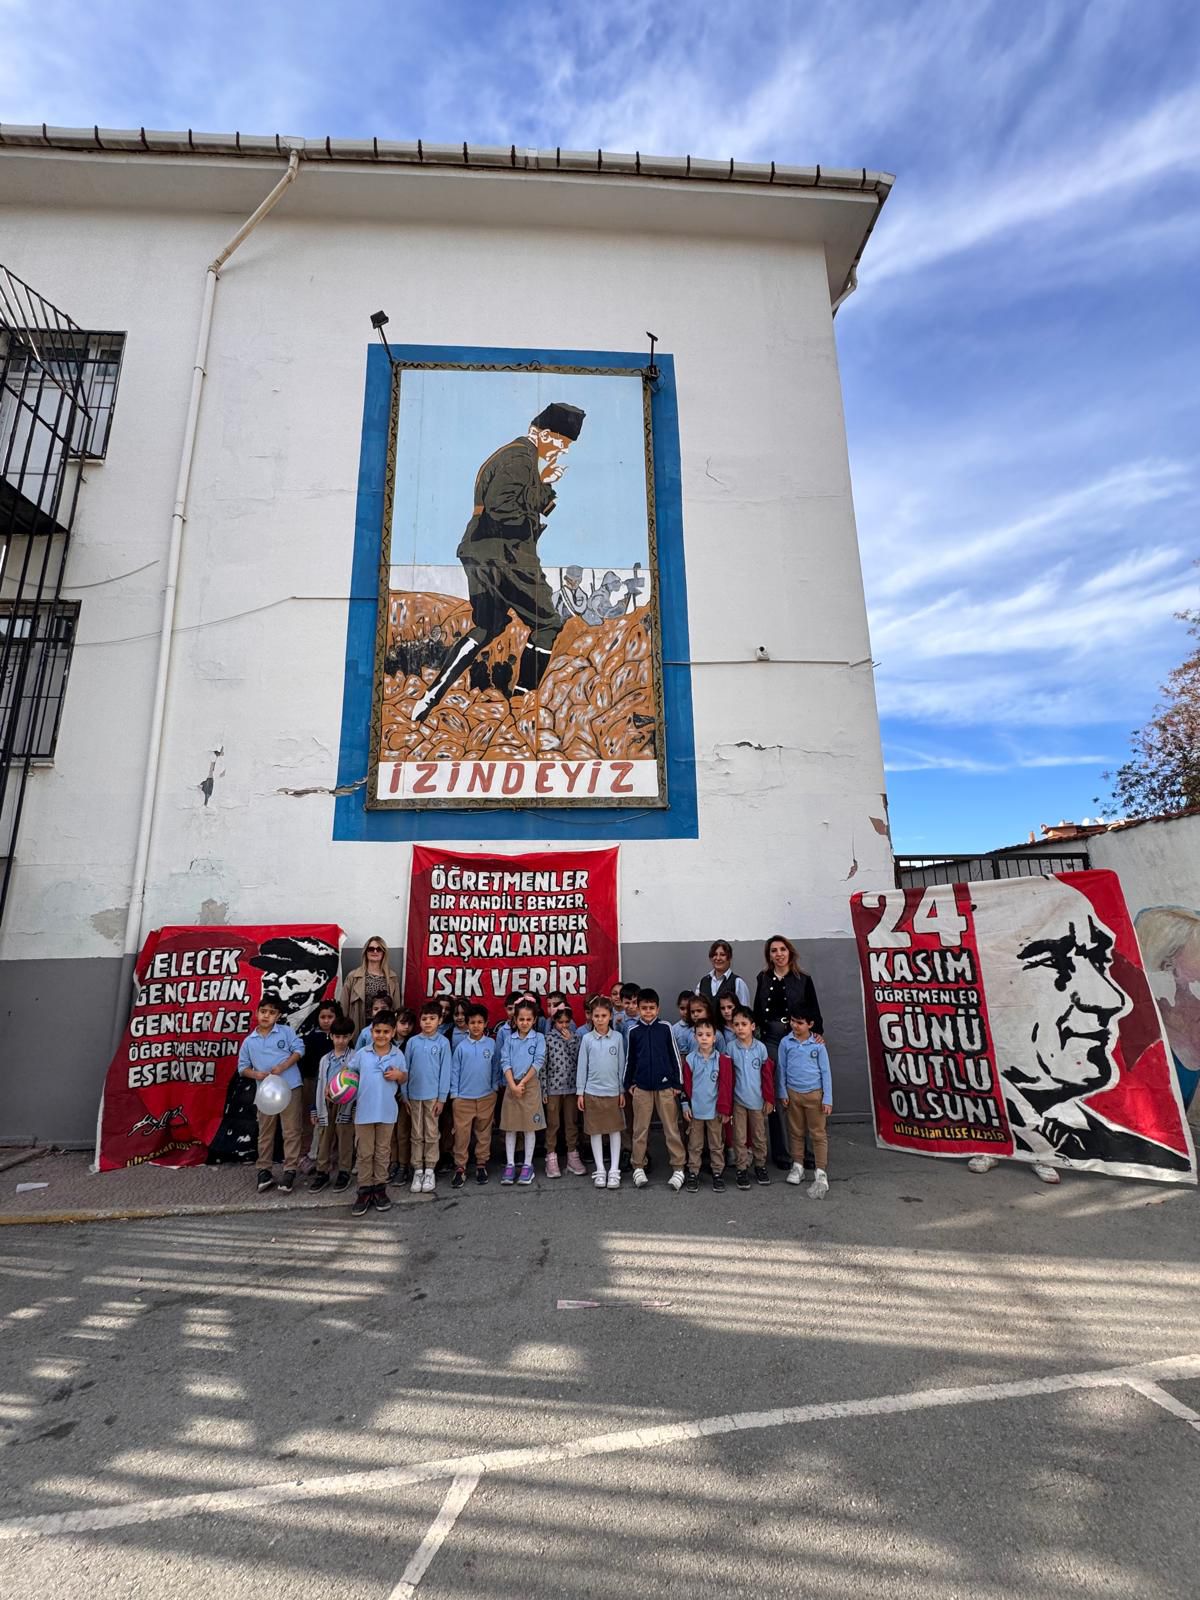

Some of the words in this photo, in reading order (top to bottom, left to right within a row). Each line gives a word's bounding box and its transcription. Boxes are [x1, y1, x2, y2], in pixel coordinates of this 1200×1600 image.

[388, 762, 635, 794] İZİNDEYİZ
[431, 864, 589, 892] ÖĞRETMENLER
[429, 892, 455, 909] BİR
[527, 893, 588, 910] BENZER,
[429, 913, 495, 932] KENDİNİ
[861, 886, 968, 949] 24
[428, 932, 588, 961] BAŞKALARINA
[491, 960, 587, 996] VERİR!
[869, 951, 973, 984] KASIM
[874, 986, 978, 1004] ÖĞRETMENLER
[212, 1007, 251, 1033] İSE
[879, 1006, 982, 1052] GÜNÜ
[884, 1053, 992, 1091] KUTLU
[890, 1090, 1000, 1127] OLSUN!
